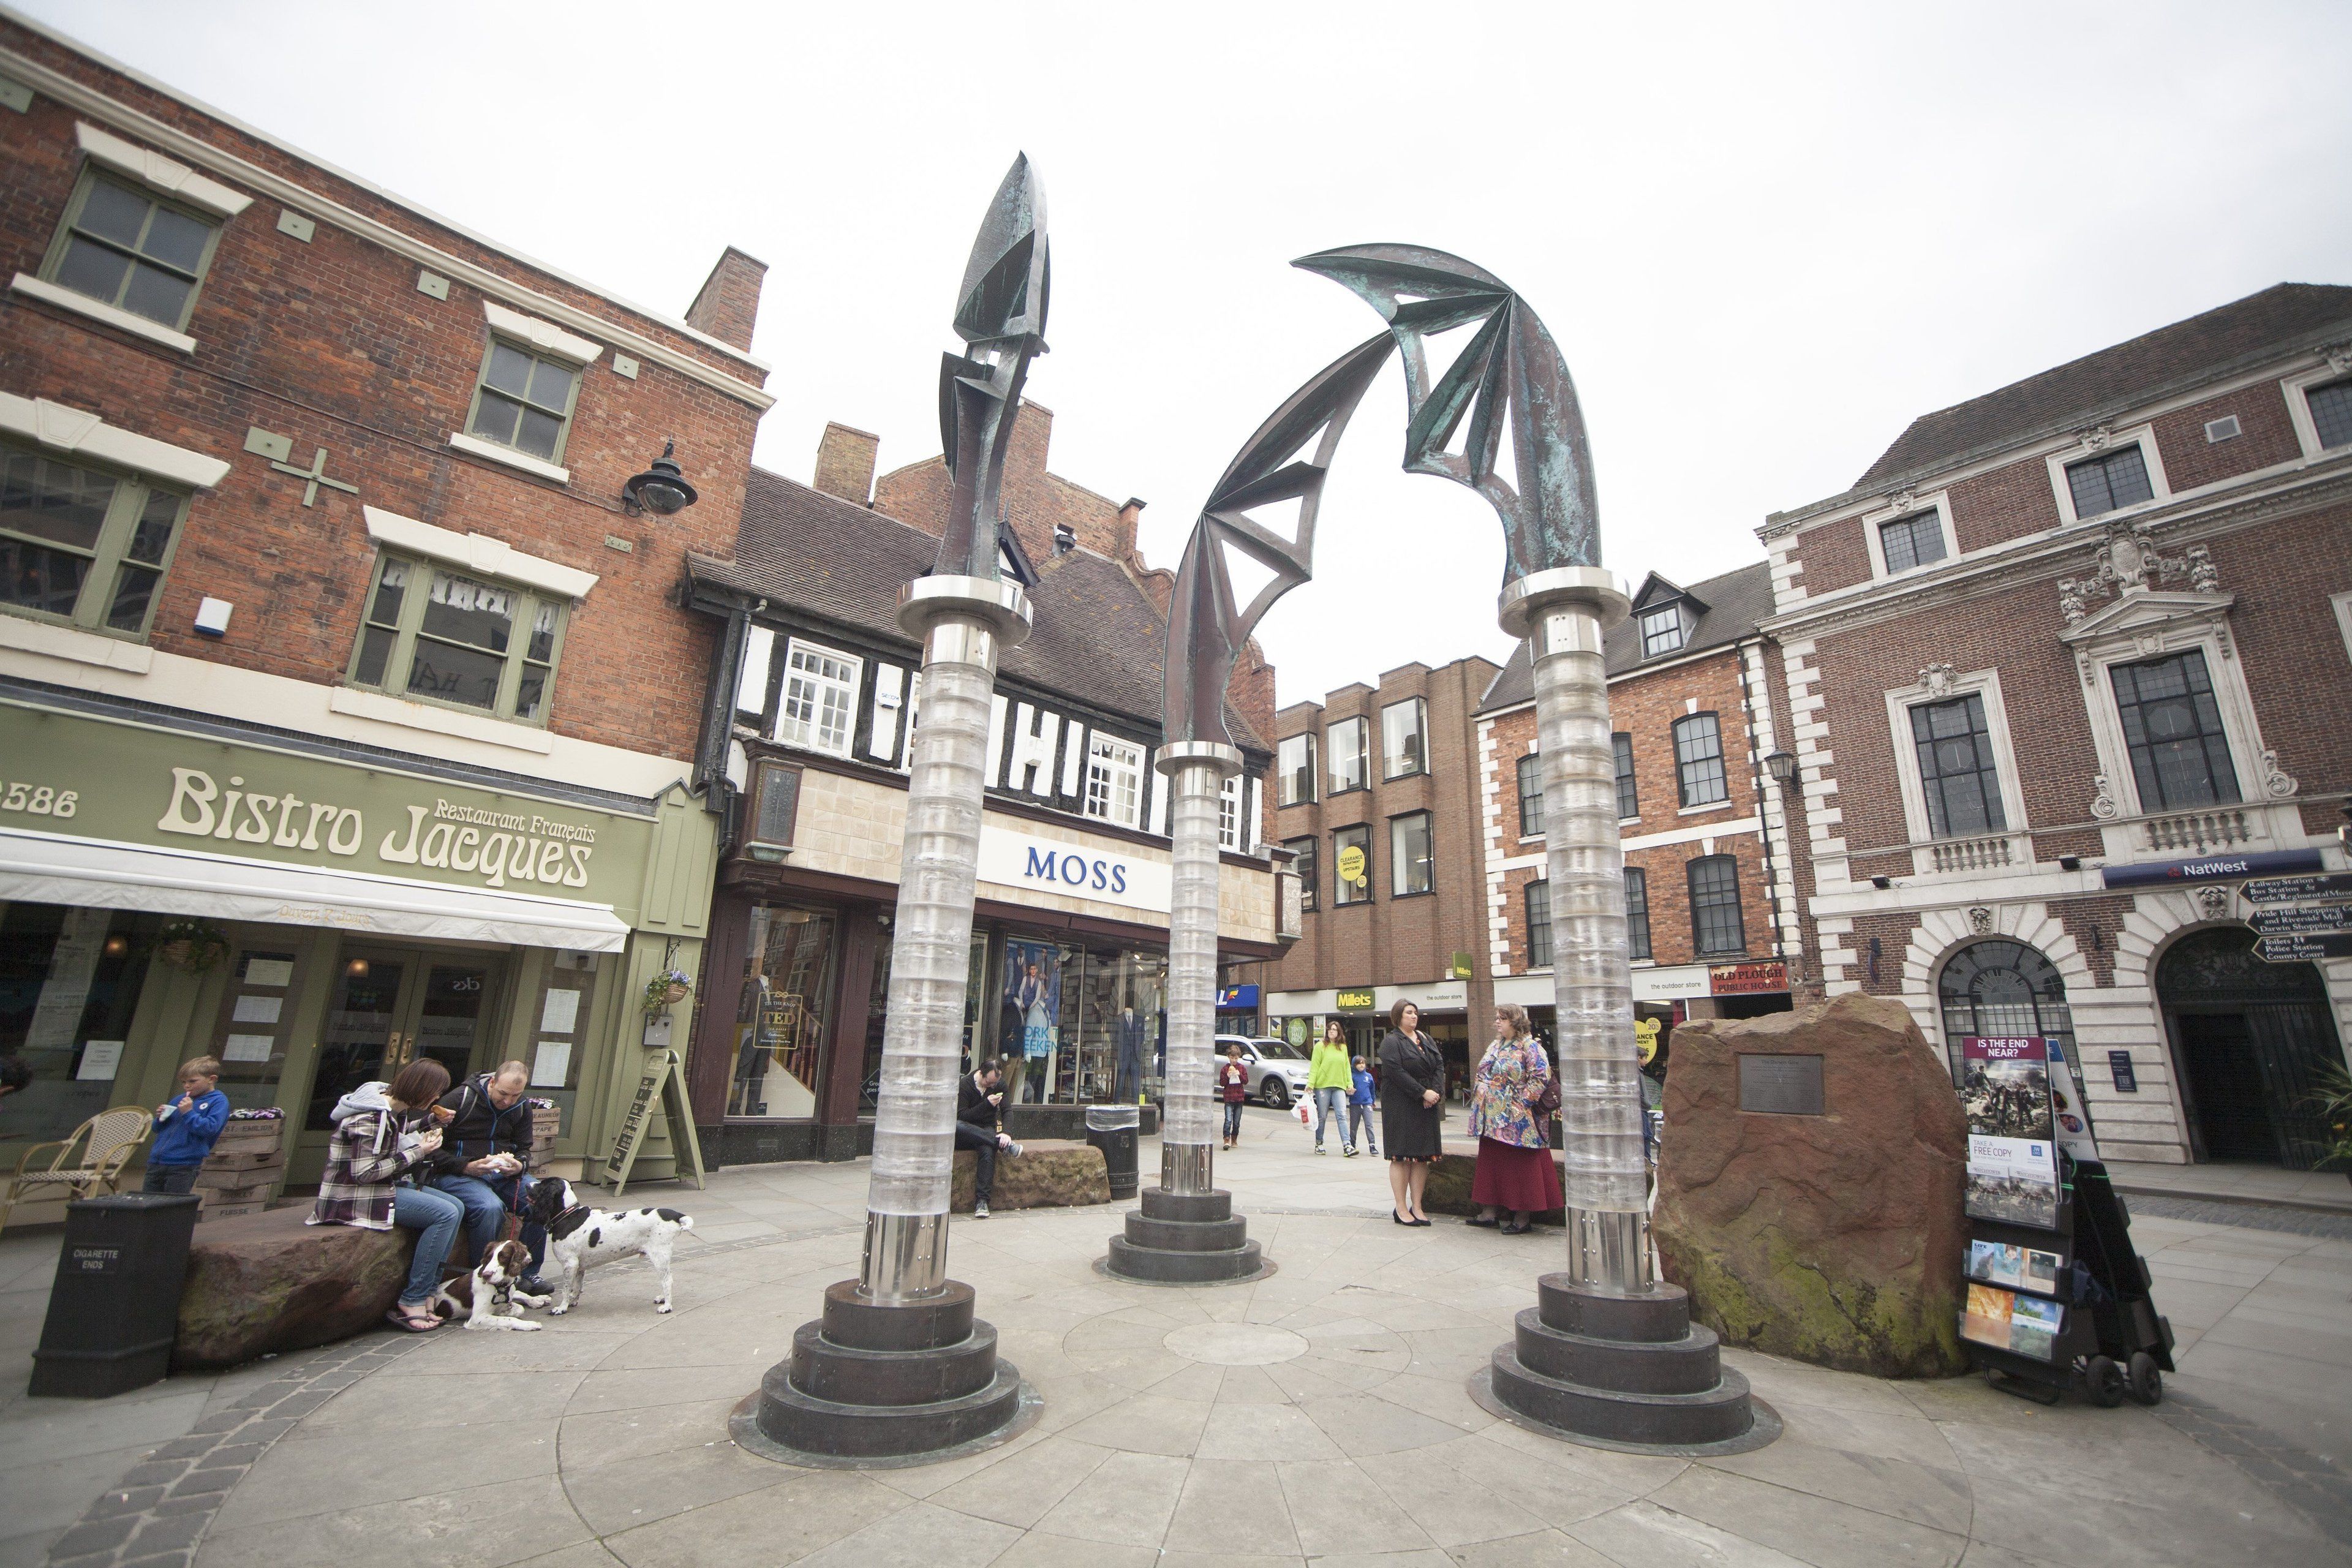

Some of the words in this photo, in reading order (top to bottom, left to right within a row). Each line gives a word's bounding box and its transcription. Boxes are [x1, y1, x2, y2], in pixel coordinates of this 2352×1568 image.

[0, 780, 79, 818] 586
[434, 798, 526, 832] Restaurant
[529, 815, 596, 843] Français
[157, 767, 363, 855] Bistro
[379, 805, 592, 888] Jacques
[1340, 854, 1363, 863] CLEARANCE
[1024, 846, 1126, 894] MOSS
[2184, 861, 2248, 875] NatWest
[2252, 891, 2328, 902] Castle/Regimental
[337, 911, 371, 924] Jours
[2299, 907, 2339, 916] Shopping
[2293, 922, 2333, 931] Shopping
[1457, 967, 1471, 976] Millets
[1714, 972, 1735, 981] OLD
[1738, 969, 1783, 981] PLOUGH
[1718, 983, 1748, 992] PUBLIC
[1751, 981, 1782, 990] HOUSE
[1338, 993, 1371, 1007] Millets
[763, 1011, 796, 1025] TED
[1023, 1039, 1058, 1052] EEKEN
[1978, 1039, 1986, 1047] IS
[1988, 1039, 2006, 1048] THE
[2008, 1039, 2029, 1048] END
[1988, 1049, 2019, 1058] NEAR?
[1974, 1146, 1991, 1156] FREE
[1992, 1148, 2012, 1158] COPY
[74, 1250, 119, 1259] CIGARETTE
[82, 1260, 104, 1269] ENDS
